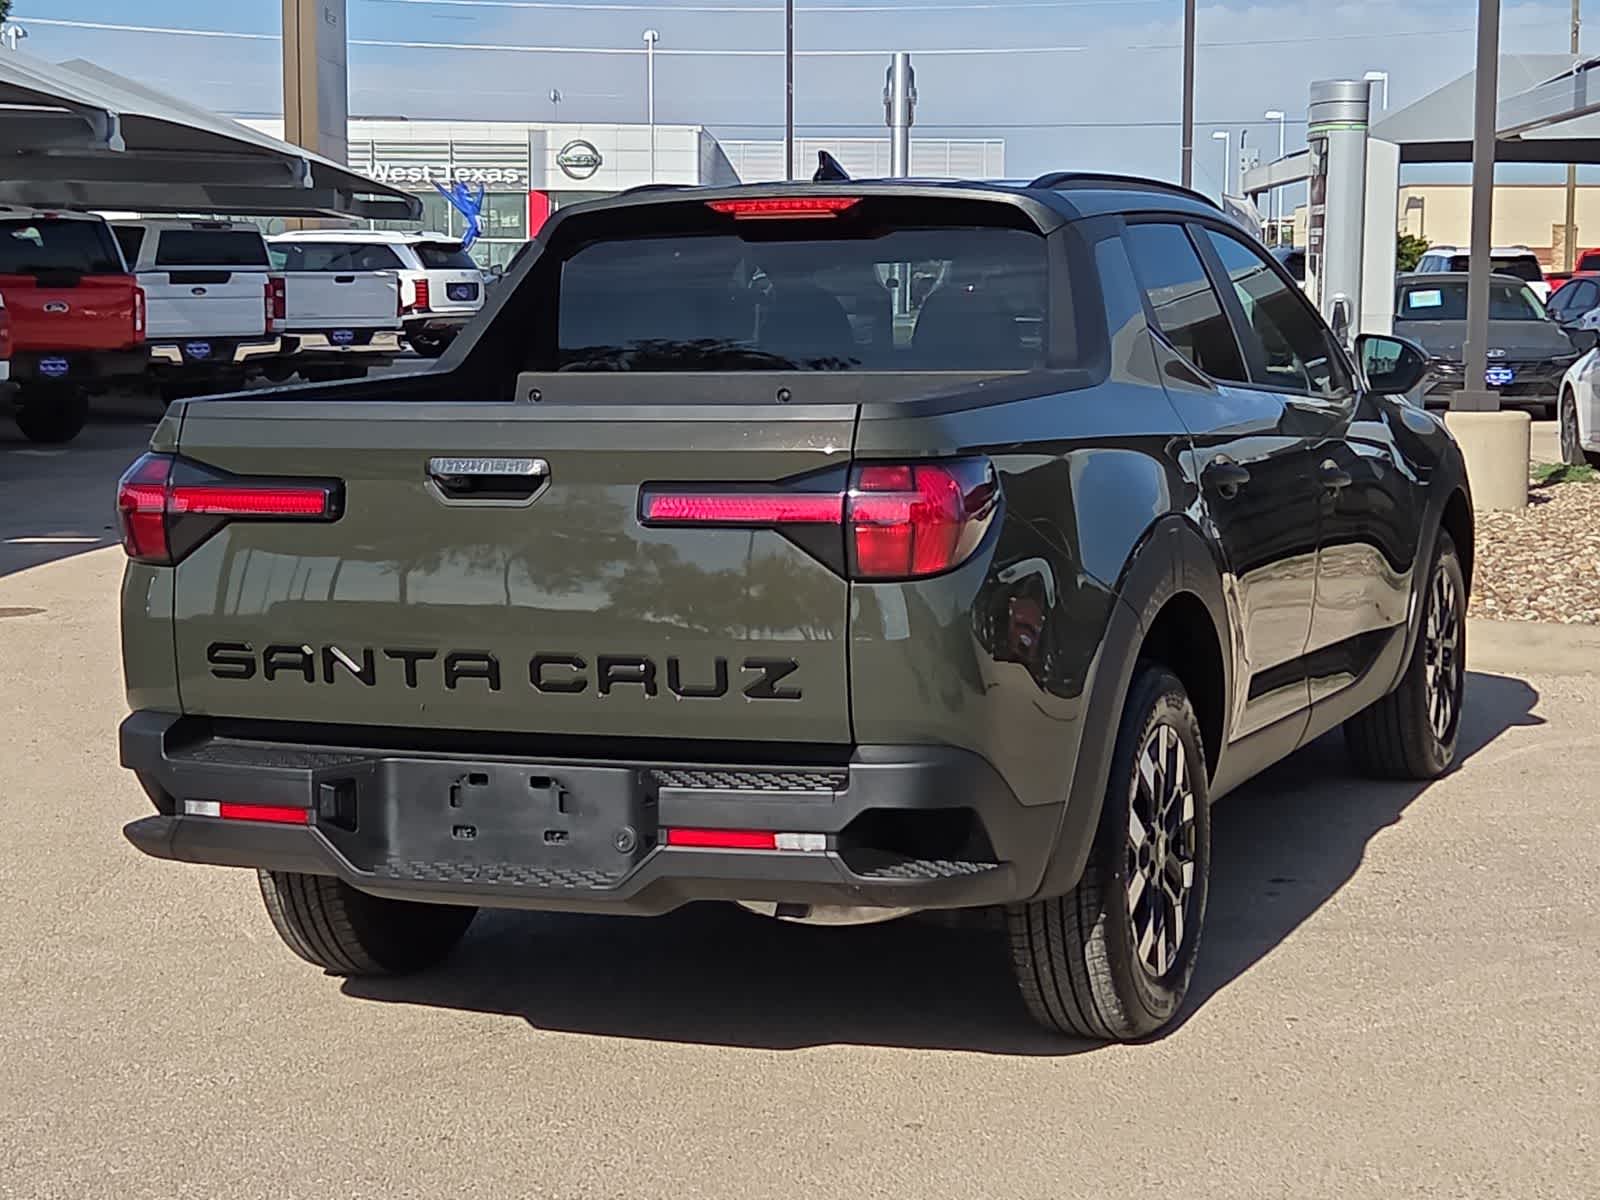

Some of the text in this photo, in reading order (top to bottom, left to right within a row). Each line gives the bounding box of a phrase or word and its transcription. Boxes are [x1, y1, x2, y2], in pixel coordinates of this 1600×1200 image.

[367, 163, 520, 182] West Texas
[207, 641, 802, 701] SANTA CRUZ
